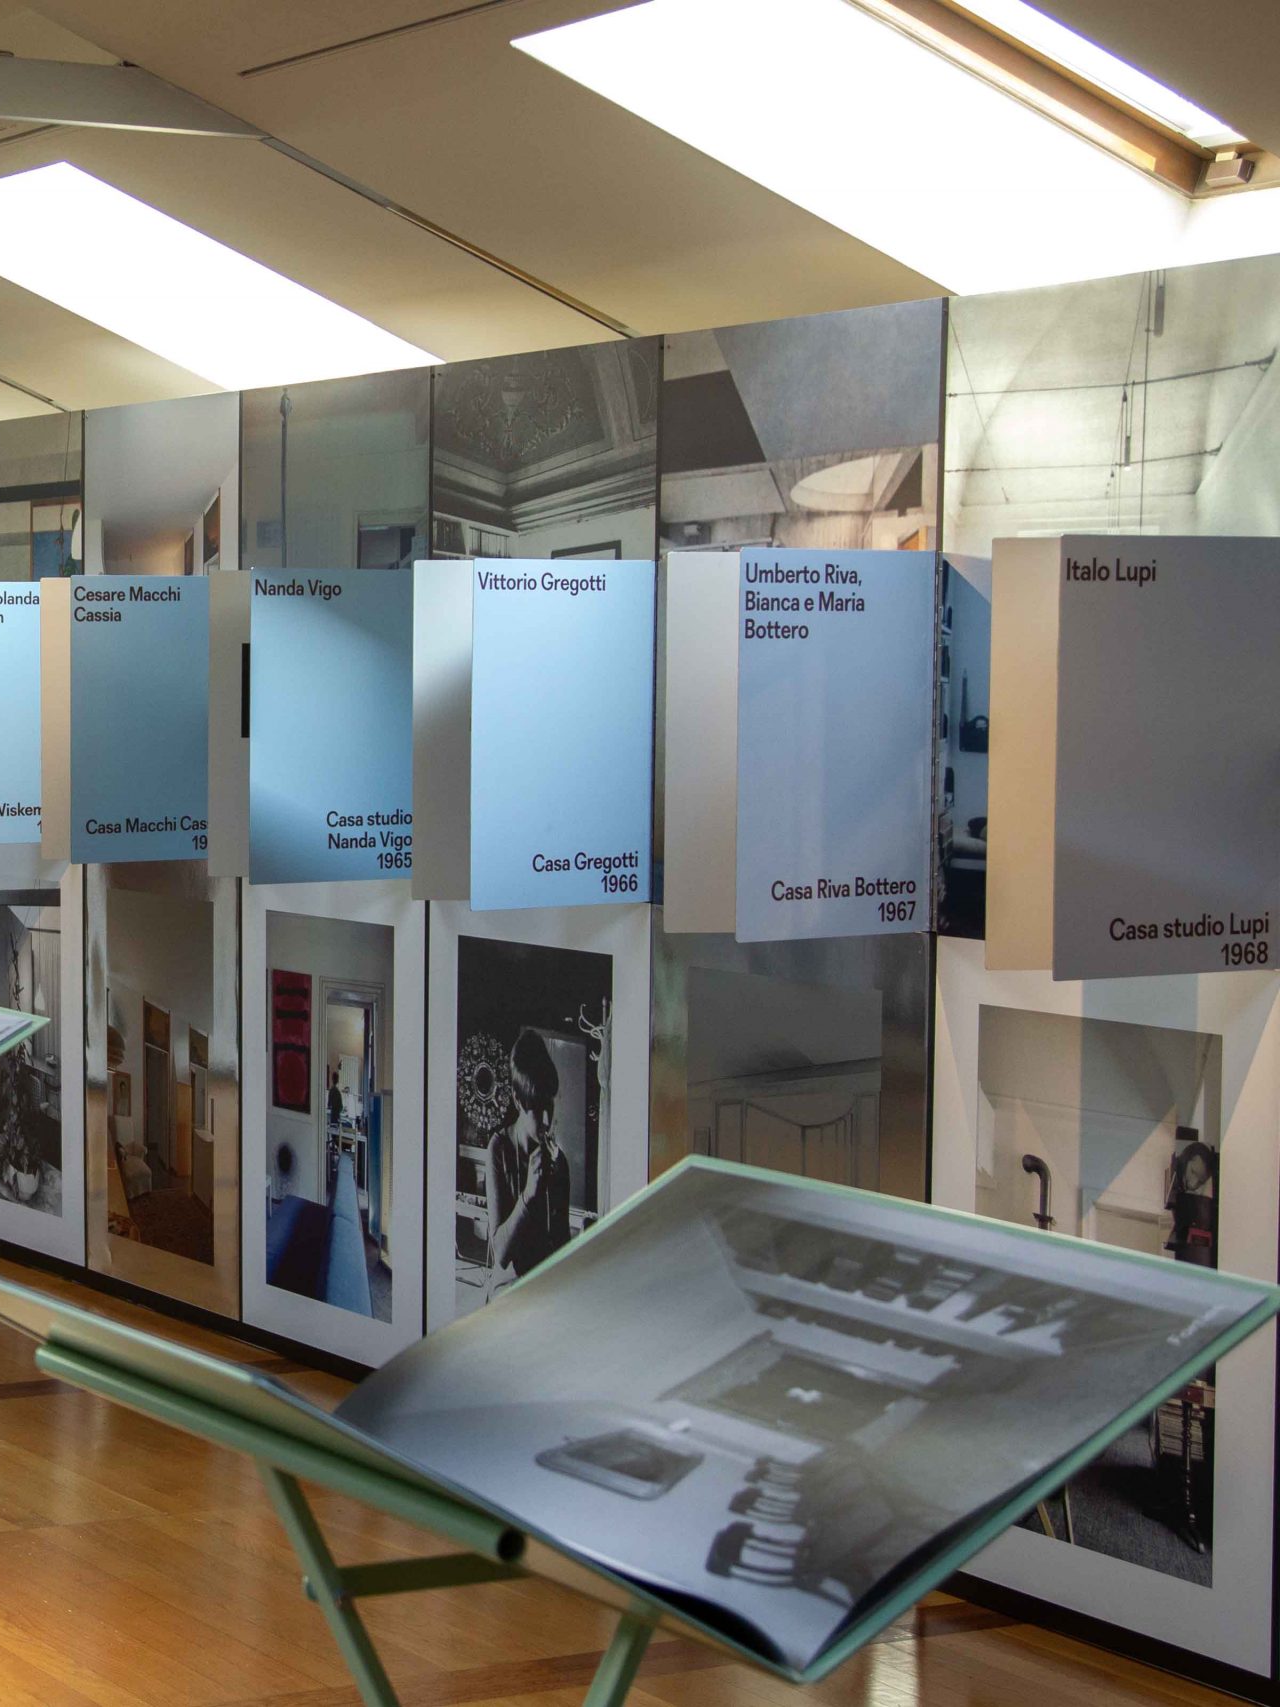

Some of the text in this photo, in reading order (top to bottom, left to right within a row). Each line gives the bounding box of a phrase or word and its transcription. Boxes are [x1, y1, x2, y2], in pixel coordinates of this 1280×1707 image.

[746, 563, 861, 586] Umberto Riva,
[1067, 558, 1156, 587] Italo Lupi
[74, 586, 180, 601] Cesare Macchi
[256, 578, 341, 600] Nanda Vigo
[478, 572, 605, 596] Vittorio Gregotti
[746, 591, 864, 611] Bianca e Maria
[74, 607, 121, 622] Cassia
[745, 619, 808, 639] Bottero
[86, 816, 207, 834] Casa Macchi Cas
[327, 809, 412, 827] Casa studio
[329, 831, 412, 853] Nanda Vigo
[377, 852, 412, 869] 1965
[533, 851, 638, 876] Casa Gregotti
[601, 873, 638, 892] 1966
[772, 877, 916, 901] Casa Riva Bottero
[878, 901, 916, 922] 1967
[1110, 912, 1269, 942] Casa studio Lupi
[1221, 941, 1268, 965] 1968
